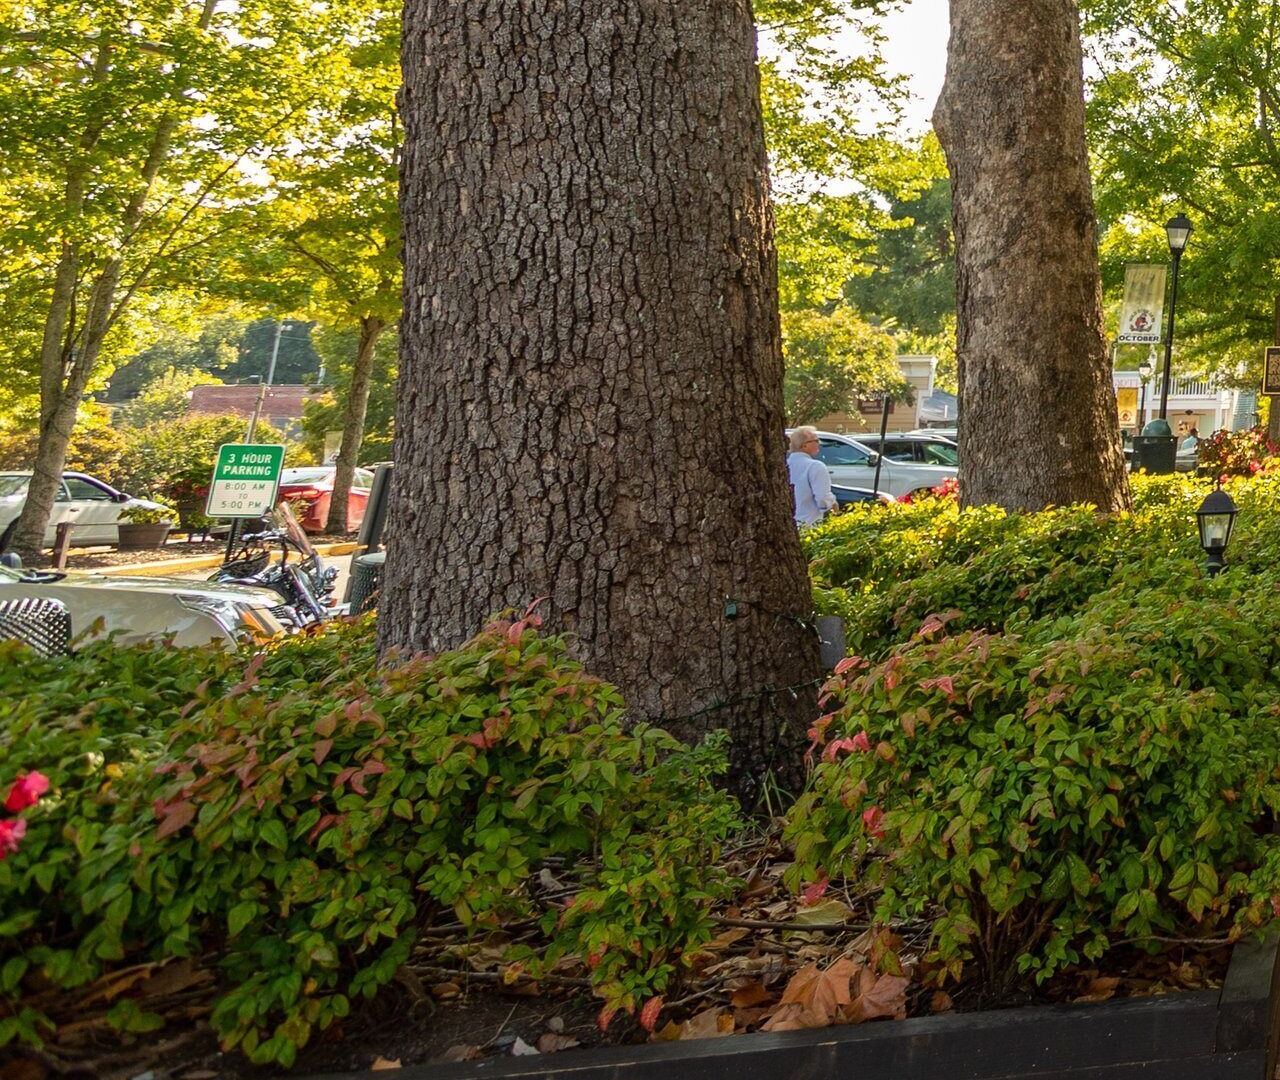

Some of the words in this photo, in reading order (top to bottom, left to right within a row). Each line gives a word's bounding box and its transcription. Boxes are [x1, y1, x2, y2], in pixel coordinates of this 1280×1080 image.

[1118, 334, 1159, 342] OCTOBER
[228, 453, 236, 464] 3
[241, 453, 272, 464] HOUR
[222, 465, 272, 476] PARKING
[225, 482, 247, 490] 8:00
[221, 500, 243, 509] 5:00
